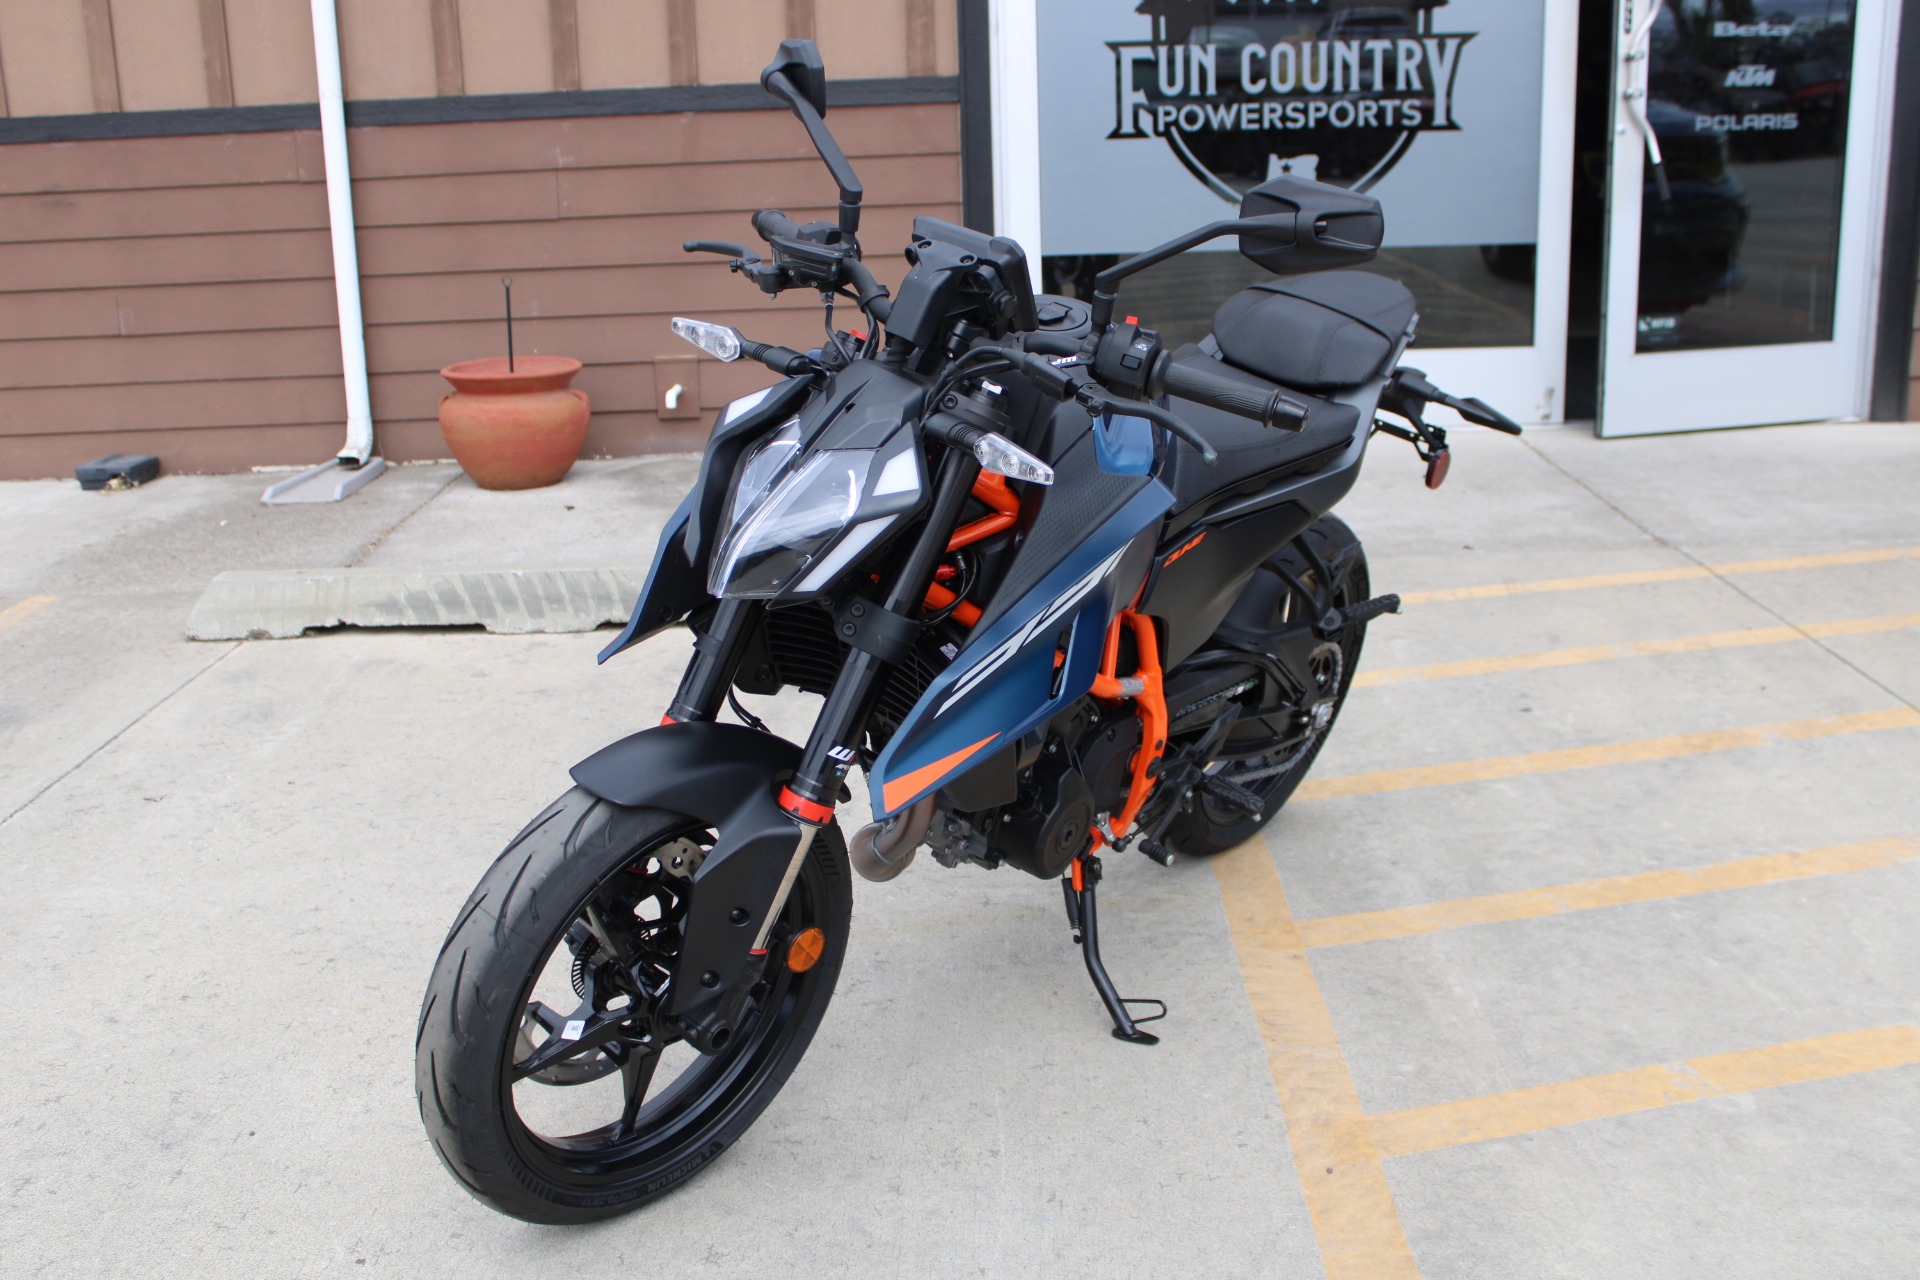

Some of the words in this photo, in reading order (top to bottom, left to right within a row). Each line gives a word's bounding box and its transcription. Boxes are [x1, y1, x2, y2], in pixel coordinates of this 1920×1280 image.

[1713, 21, 1792, 37] Beta
[1117, 43, 1217, 134] FUN
[1240, 37, 1463, 127] COUNTRY
[1724, 64, 1777, 88] KTM
[1158, 99, 1423, 132] POWERSPORTS
[1695, 113, 1799, 132] POLARIS
[647, 1155, 702, 1193] MICHELIN
